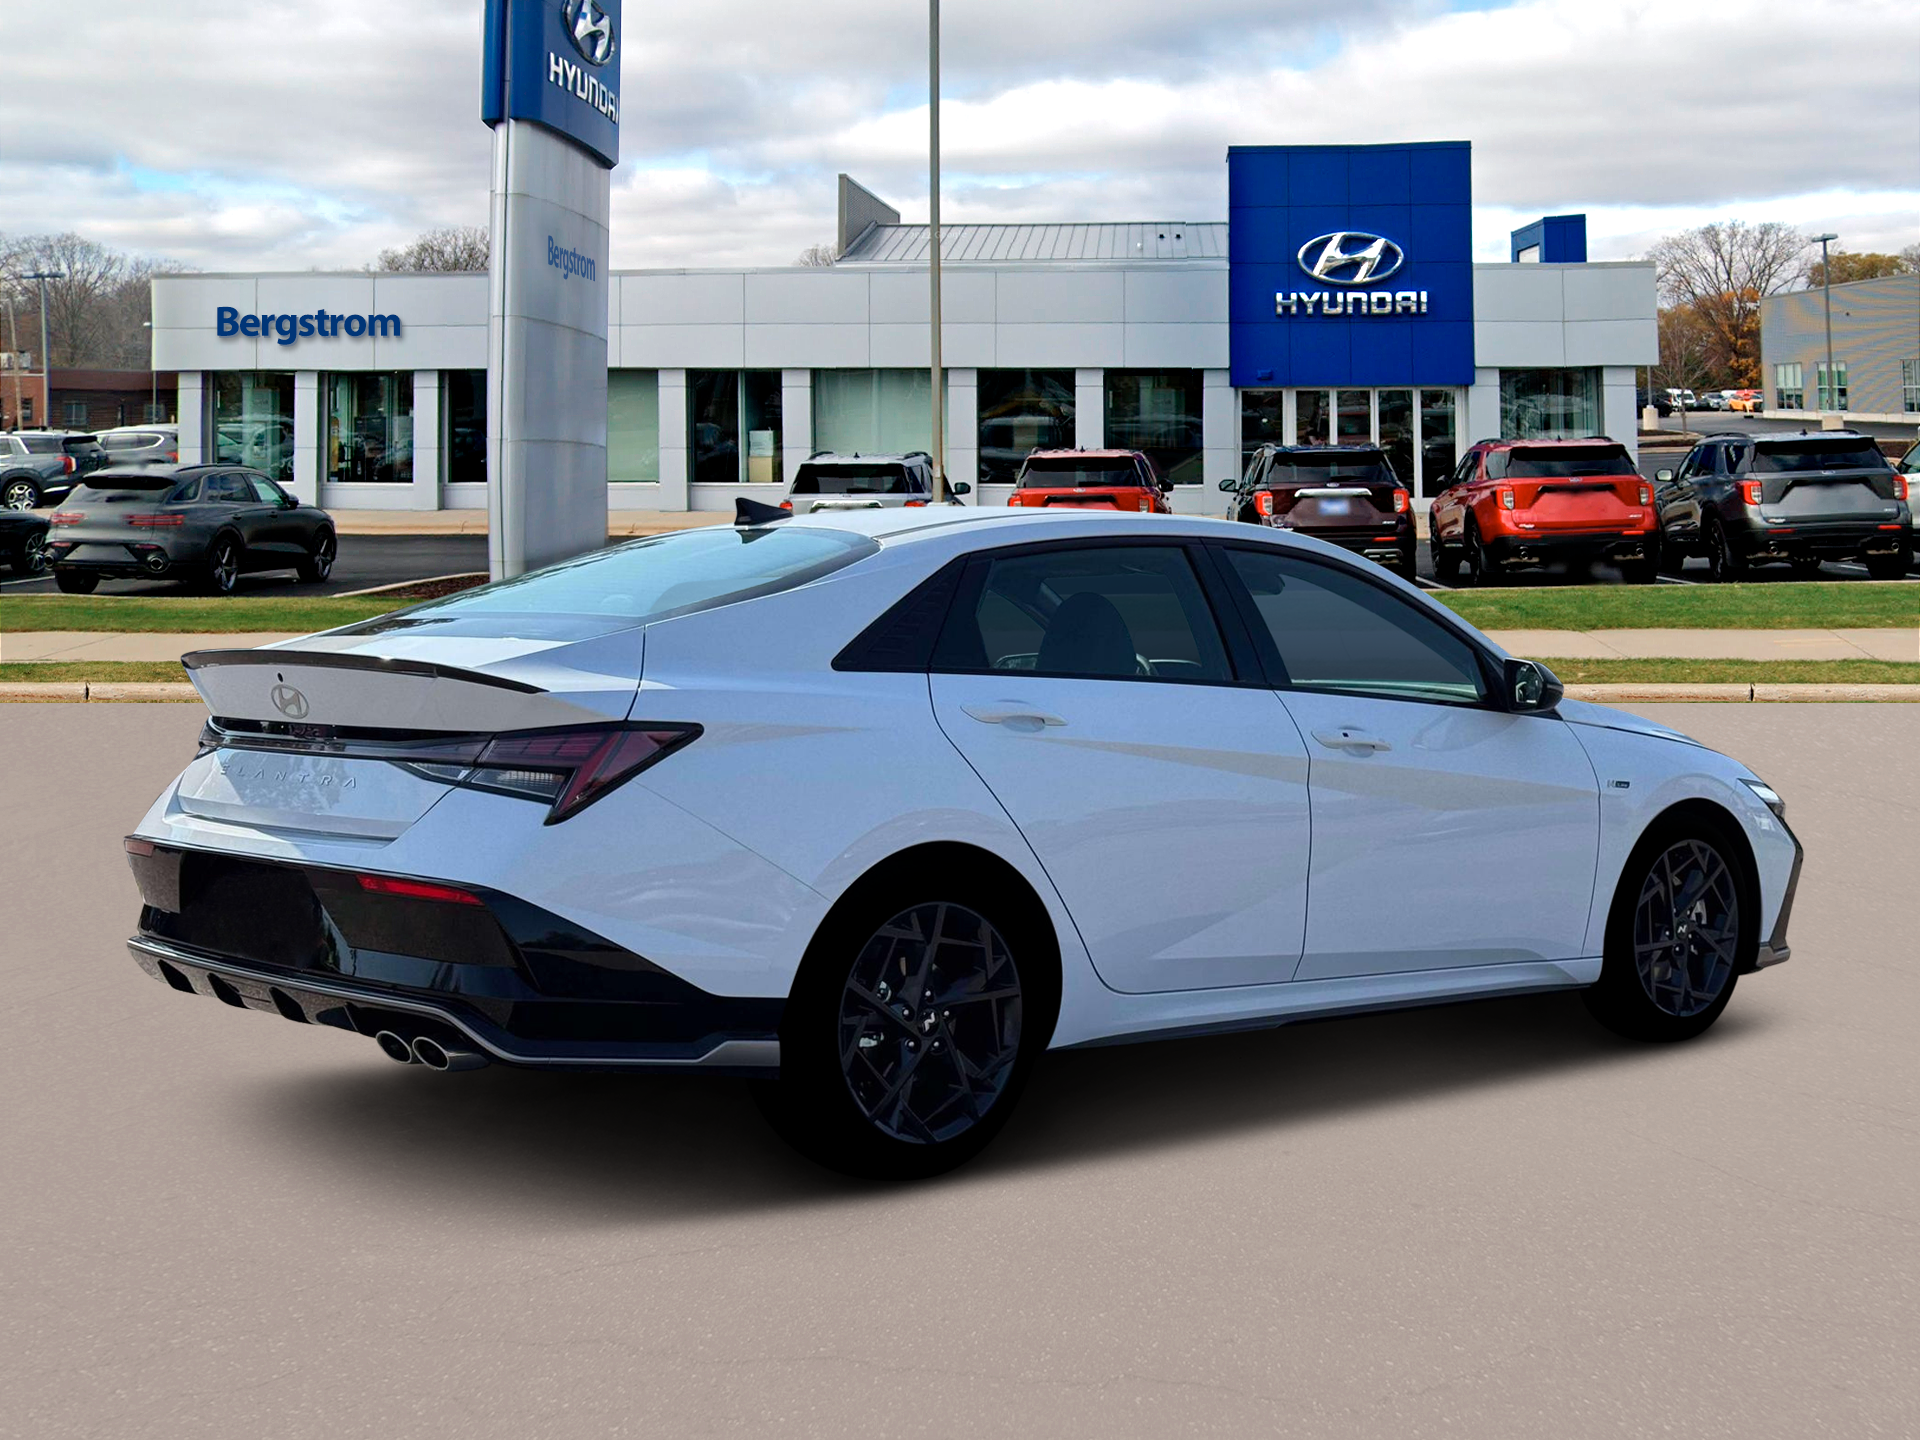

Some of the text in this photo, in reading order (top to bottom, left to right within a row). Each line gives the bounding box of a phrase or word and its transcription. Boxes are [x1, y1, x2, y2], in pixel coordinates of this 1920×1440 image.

[549, 52, 619, 124] HYUNDAI
[547, 235, 596, 281] Bergstrom
[1275, 291, 1428, 315] HYUNDAI
[216, 306, 401, 346] Bergstrom
